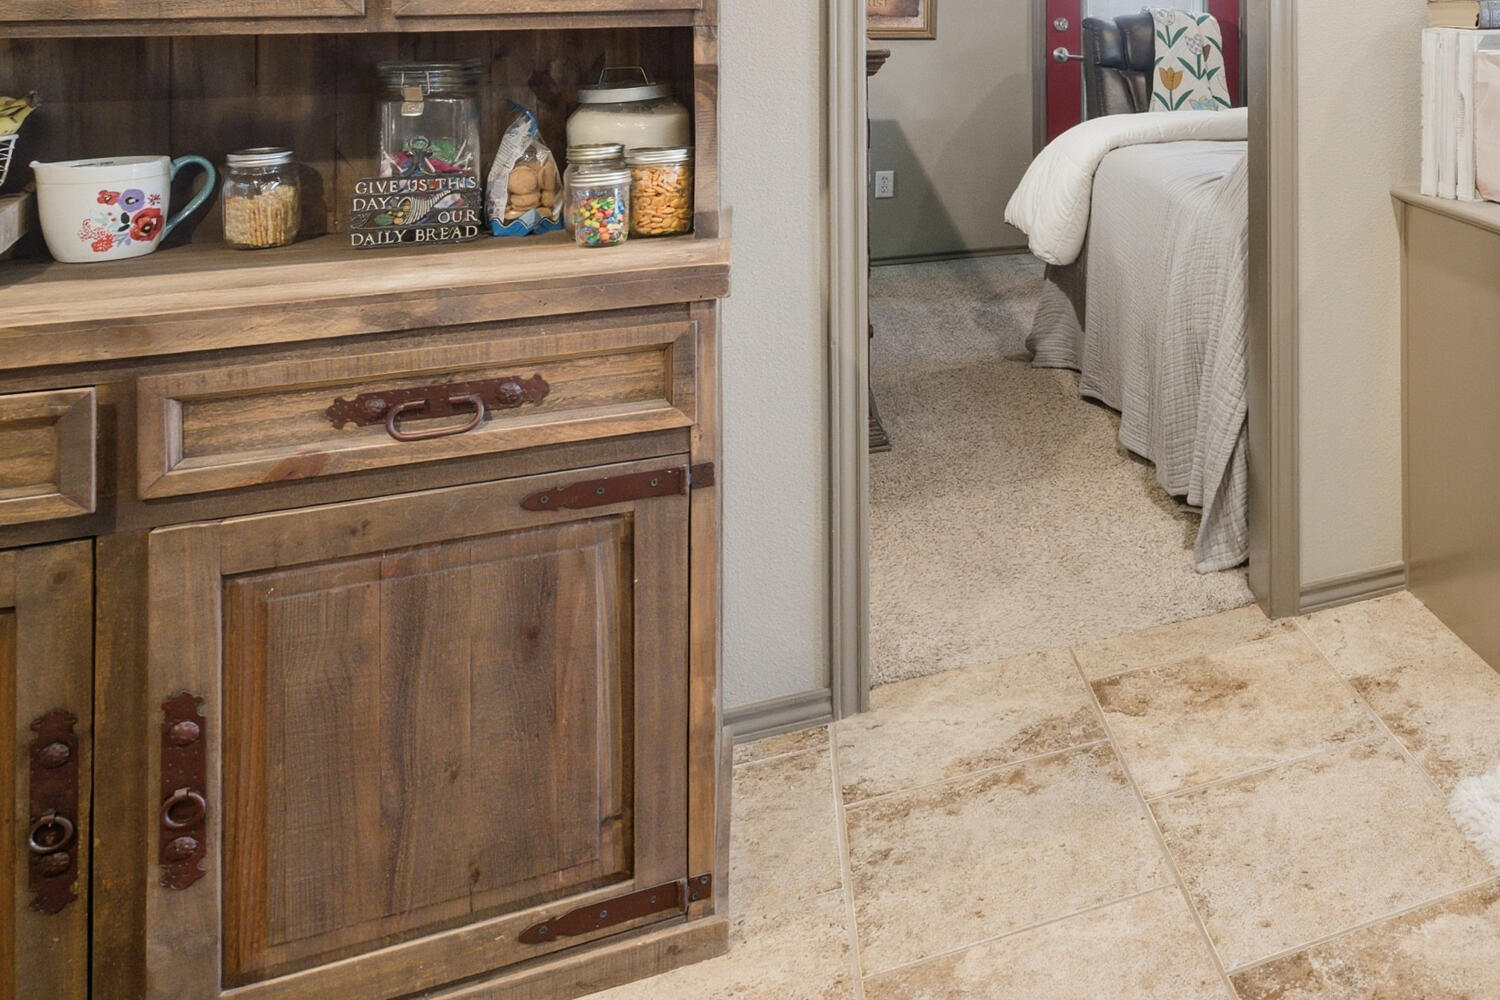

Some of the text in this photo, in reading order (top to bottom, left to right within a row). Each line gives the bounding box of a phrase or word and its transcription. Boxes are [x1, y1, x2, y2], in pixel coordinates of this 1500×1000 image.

[355, 176, 477, 194] GIVE US THIS
[353, 196, 391, 211] DAY
[438, 209, 477, 223] OUR
[351, 225, 478, 246] DAILY BREAD
